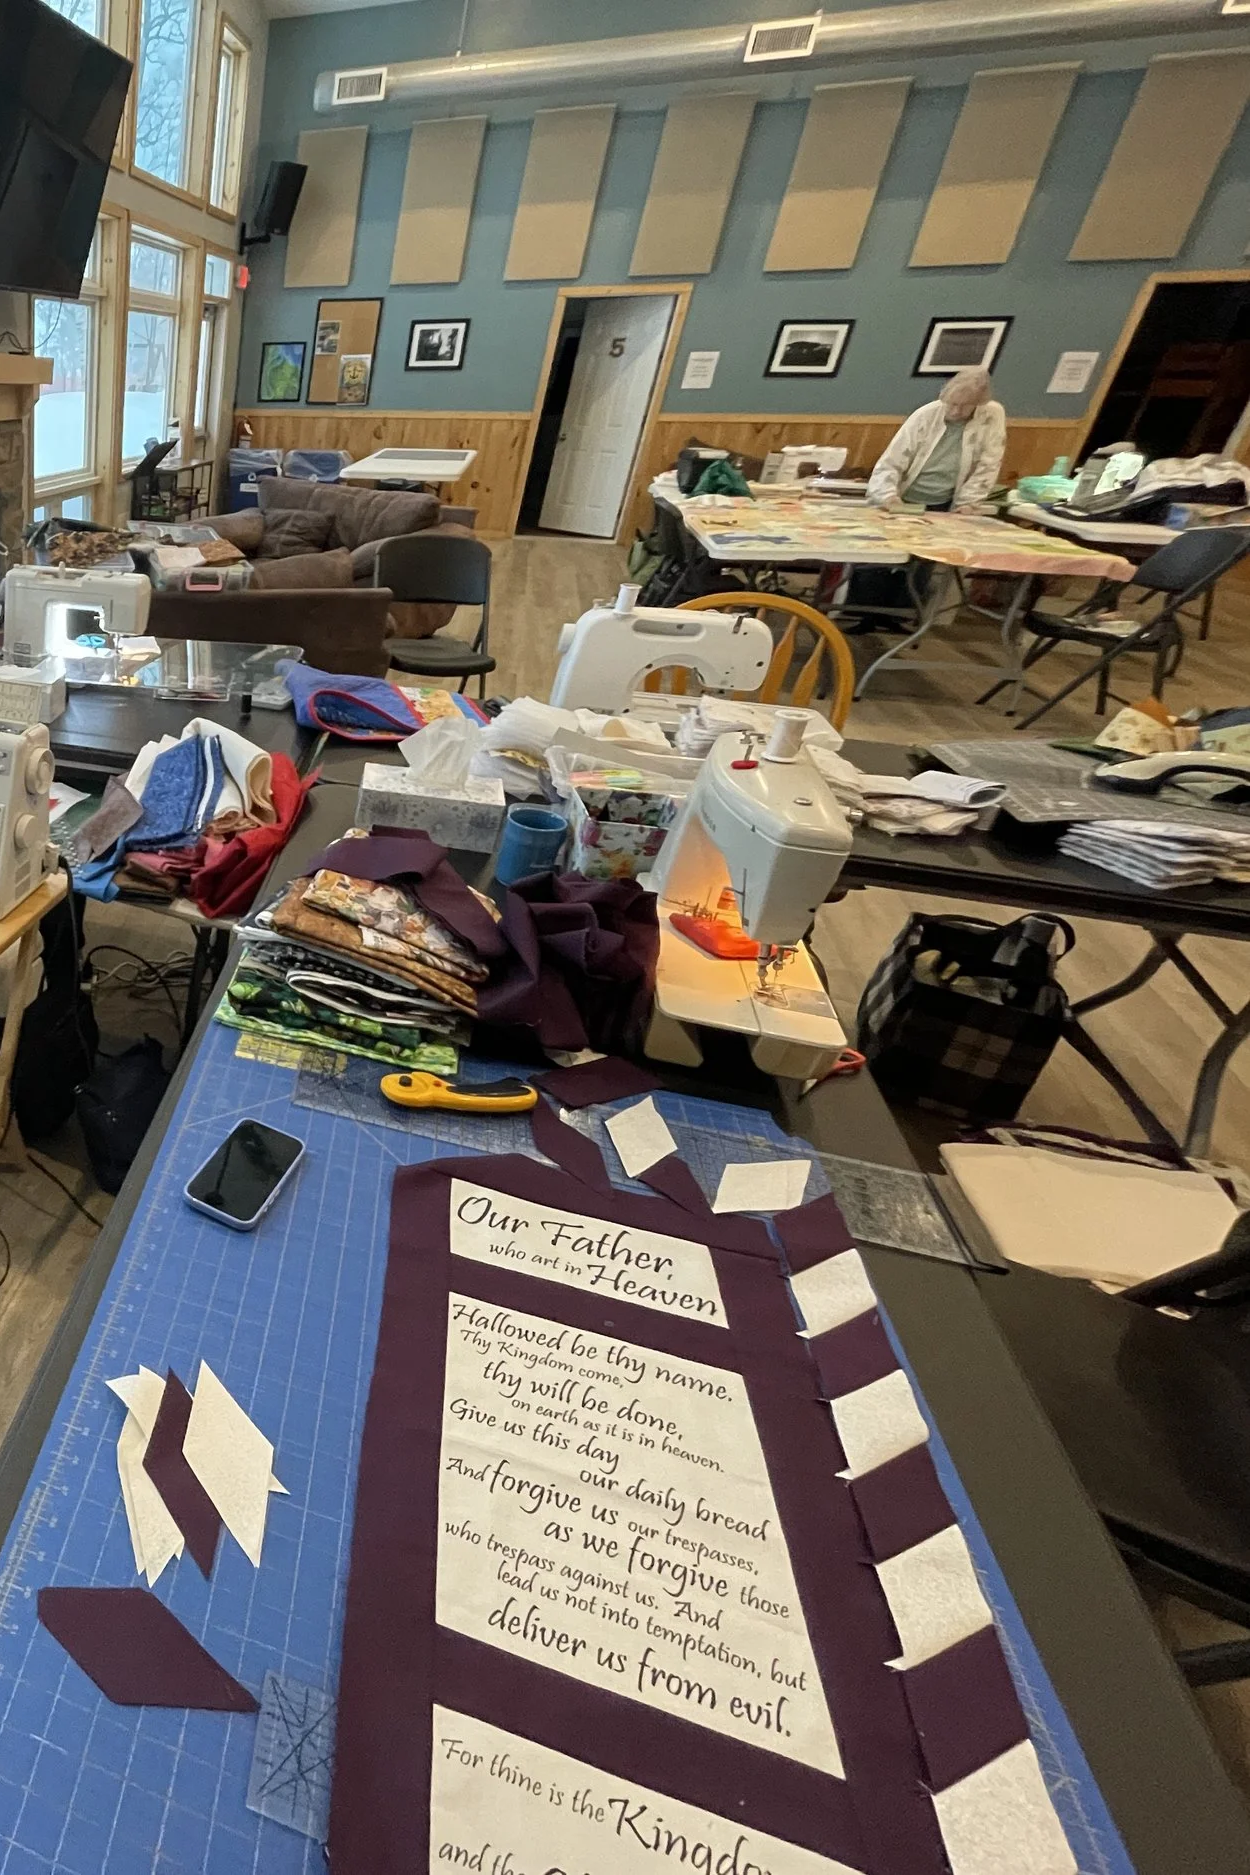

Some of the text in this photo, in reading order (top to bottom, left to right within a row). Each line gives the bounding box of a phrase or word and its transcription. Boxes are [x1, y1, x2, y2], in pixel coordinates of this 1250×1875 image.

[609, 337, 626, 358] 5
[457, 1196, 674, 1281] Our Father,
[489, 1240, 718, 1316] who art in Heaven
[452, 1303, 733, 1403] Hallowed be thy name.
[460, 1329, 624, 1389] Thy Kingdom come,
[449, 1397, 620, 1476] Give us this day
[482, 1359, 684, 1441] thy will be done,
[511, 1398, 725, 1474] on earth as it is in heaven.
[445, 1457, 759, 1576] And forgive us our trespasses.
[579, 1469, 771, 1542] our daily bread
[445, 1519, 724, 1632] who trespass against us. And
[543, 1521, 790, 1619] as we forgive those
[487, 1596, 792, 1738] deliver us from evil.
[496, 1559, 807, 1692] lead us not into temptation, but
[440, 1738, 772, 1875] For thine is the Kingdo
[438, 1842, 526, 1875] and th
